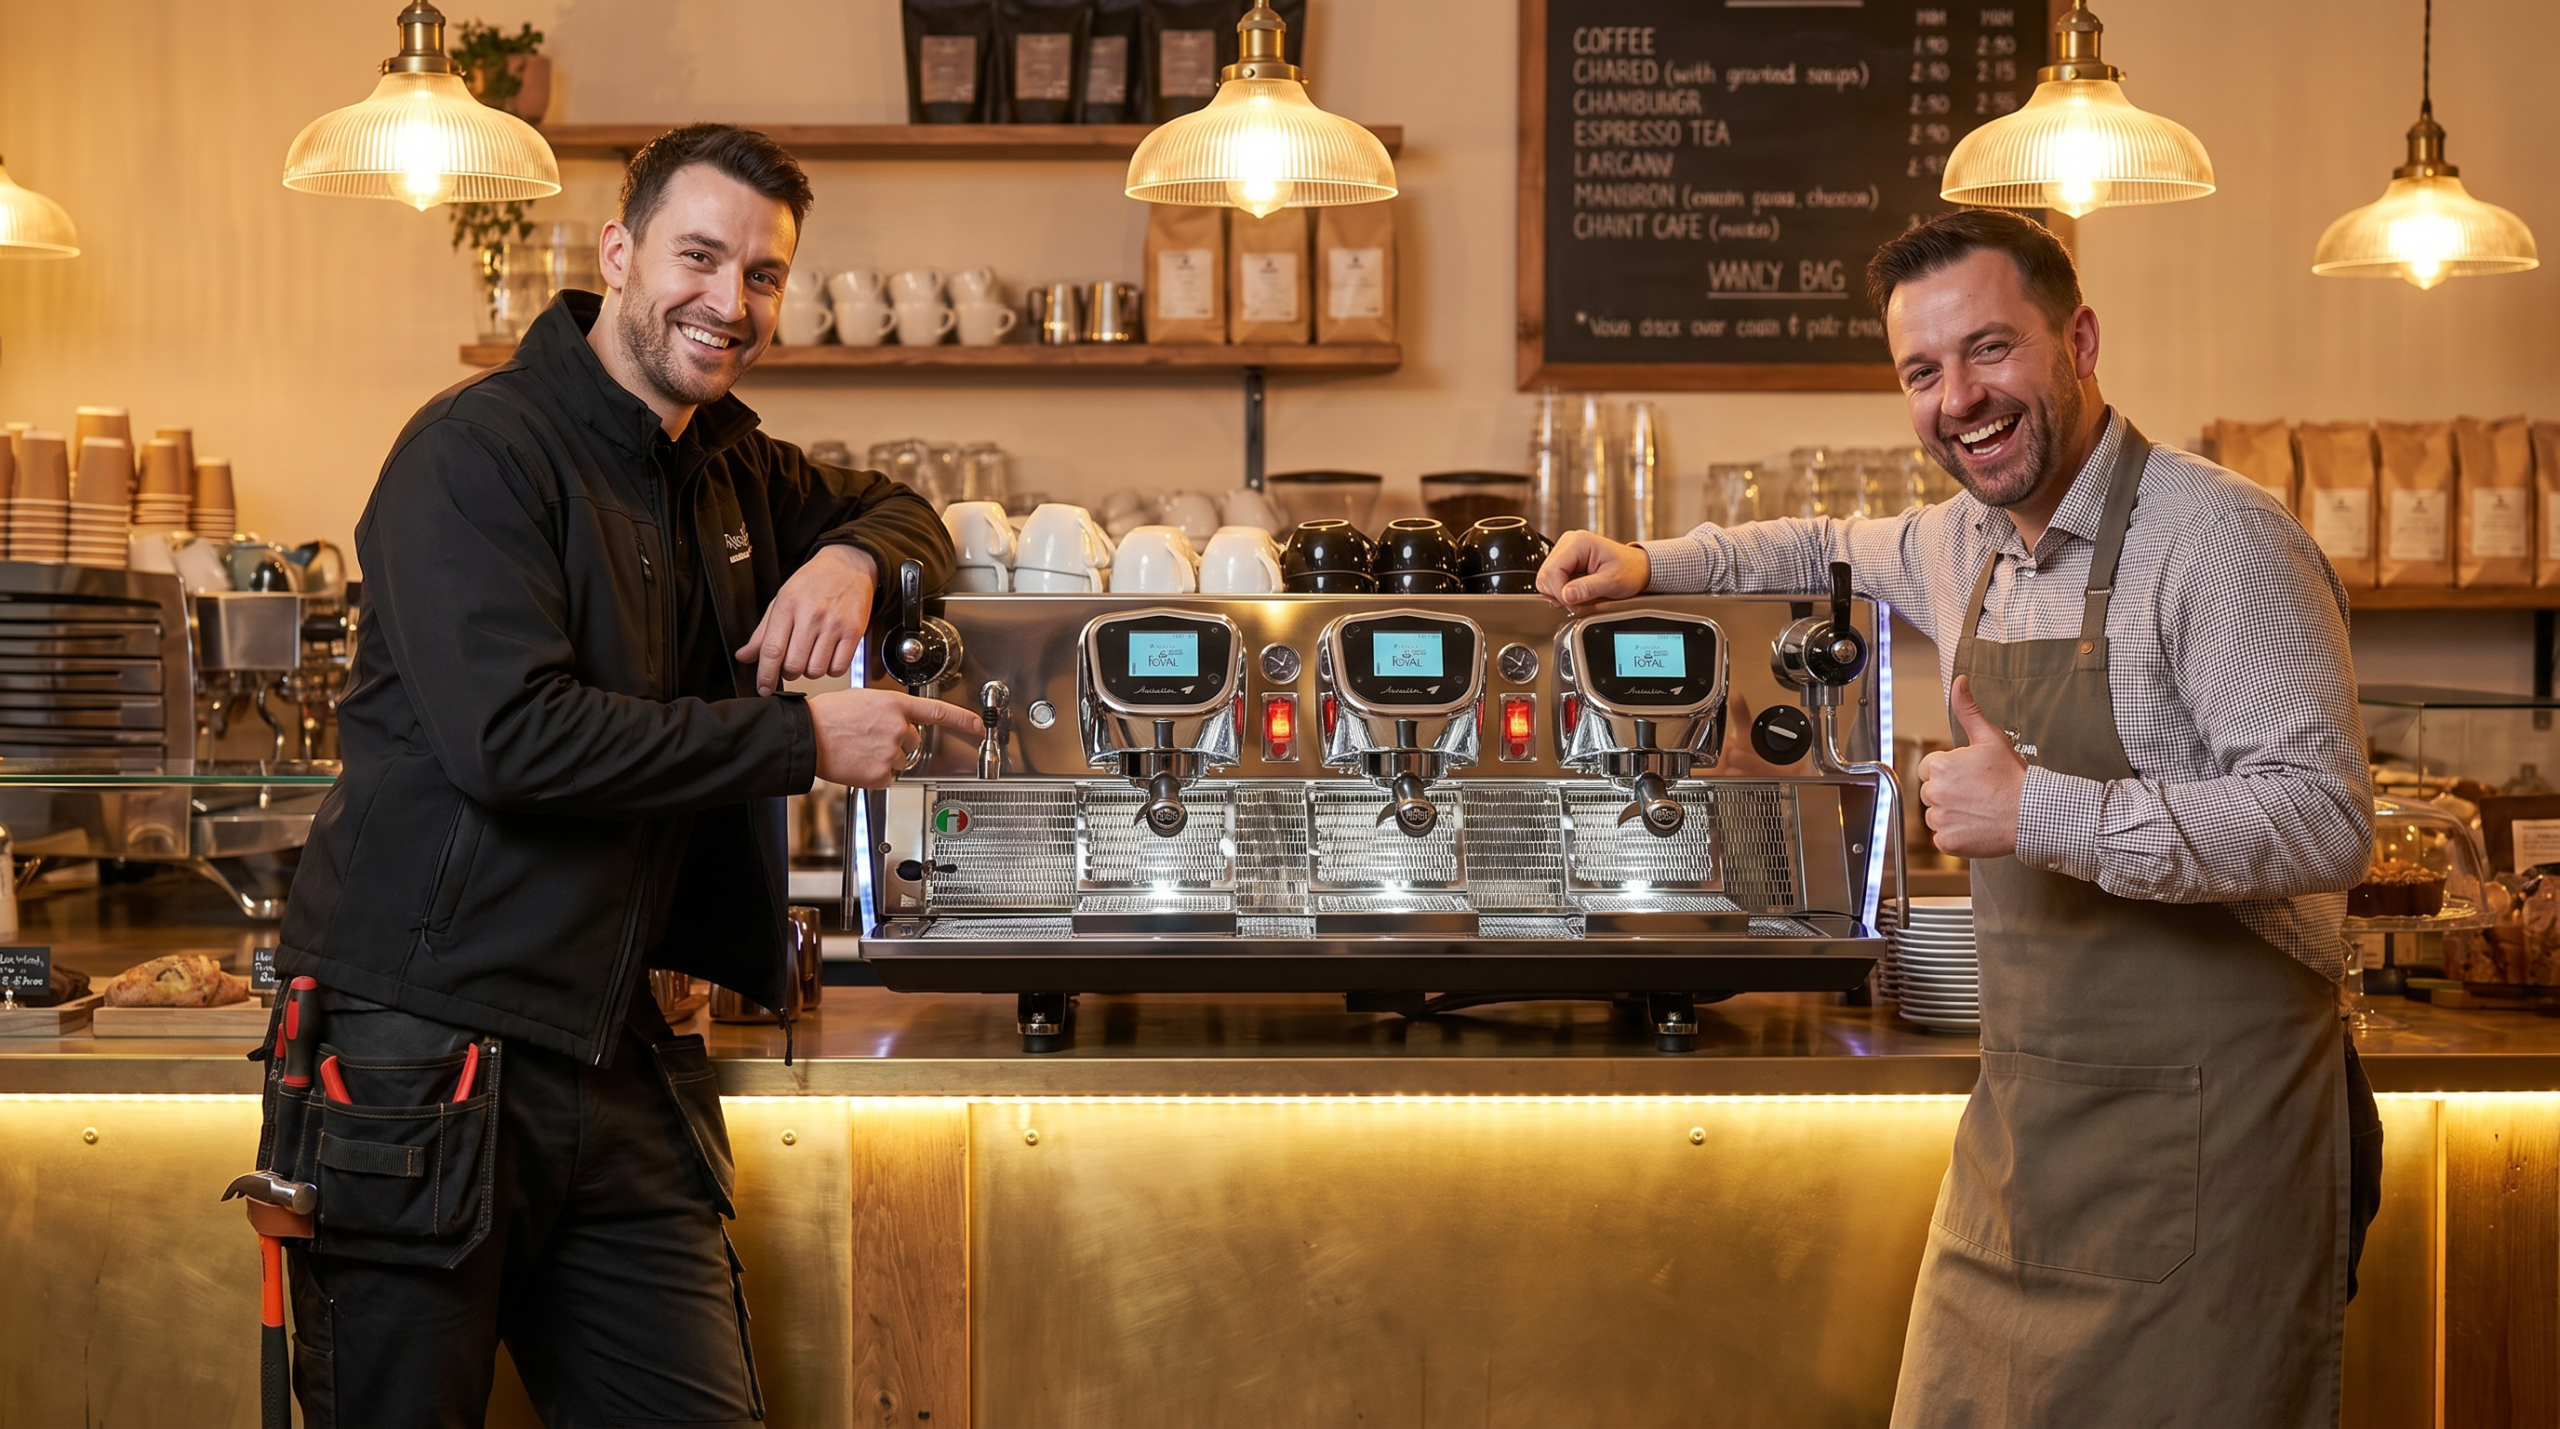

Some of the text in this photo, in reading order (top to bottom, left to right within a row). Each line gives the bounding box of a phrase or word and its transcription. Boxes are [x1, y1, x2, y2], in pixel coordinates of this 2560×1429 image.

[1573, 27, 1655, 55] COFFEE
[1573, 58, 1659, 85] CHARED
[1574, 119, 1731, 147] ESPRESSO TEA
[1652, 212, 1703, 239] CAFE
[1800, 260, 1846, 291] BAG
